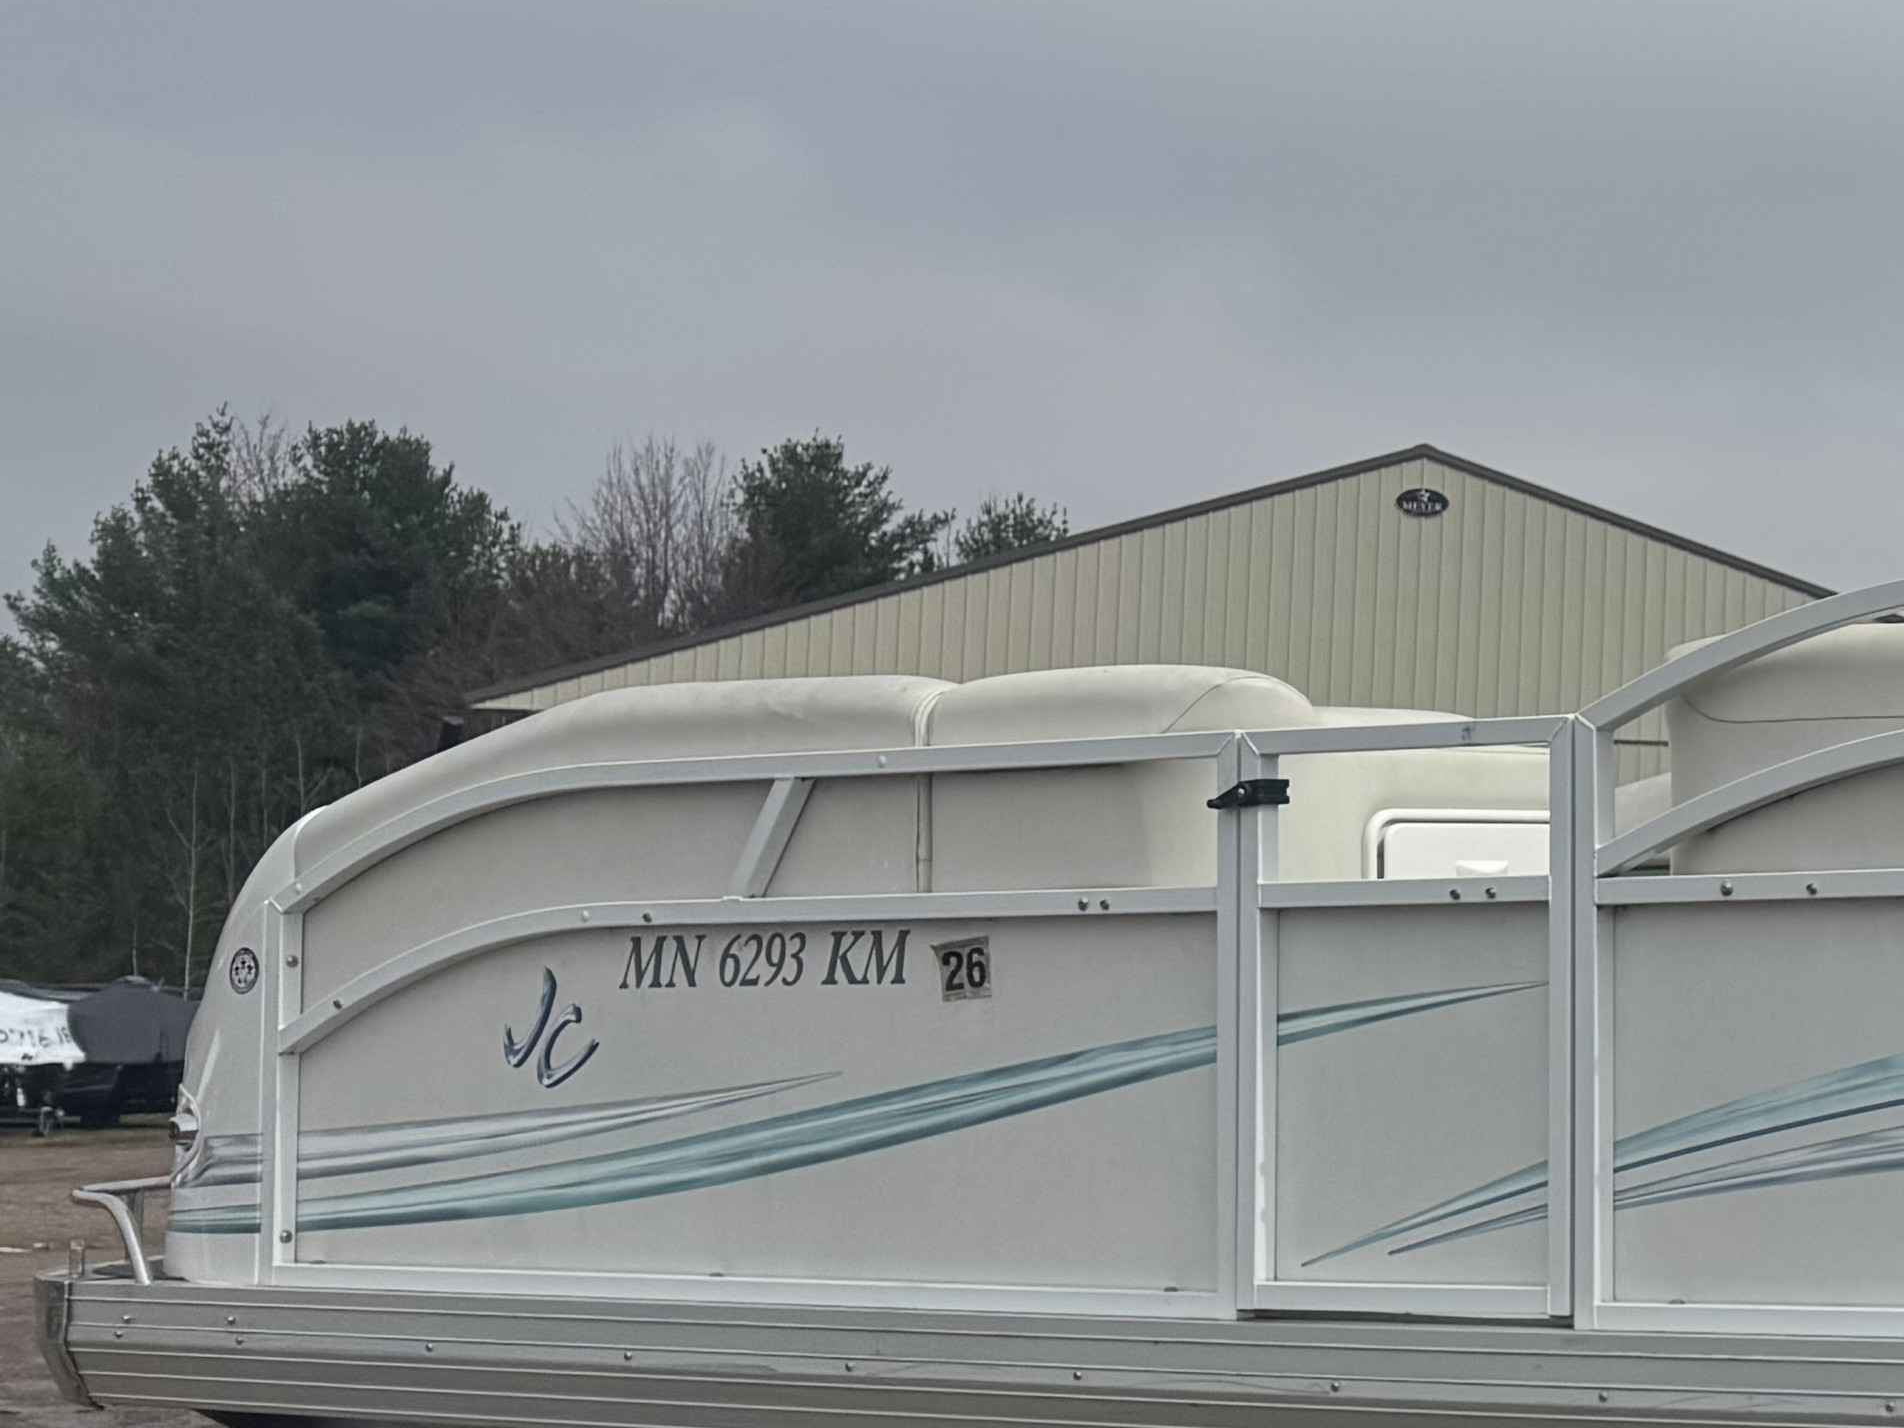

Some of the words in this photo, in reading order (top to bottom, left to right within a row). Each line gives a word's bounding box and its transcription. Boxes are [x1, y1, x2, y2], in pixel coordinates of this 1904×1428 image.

[619, 934, 706, 990] MN
[719, 932, 806, 988] 6293
[820, 929, 910, 986] KM
[942, 947, 986, 991] 26
